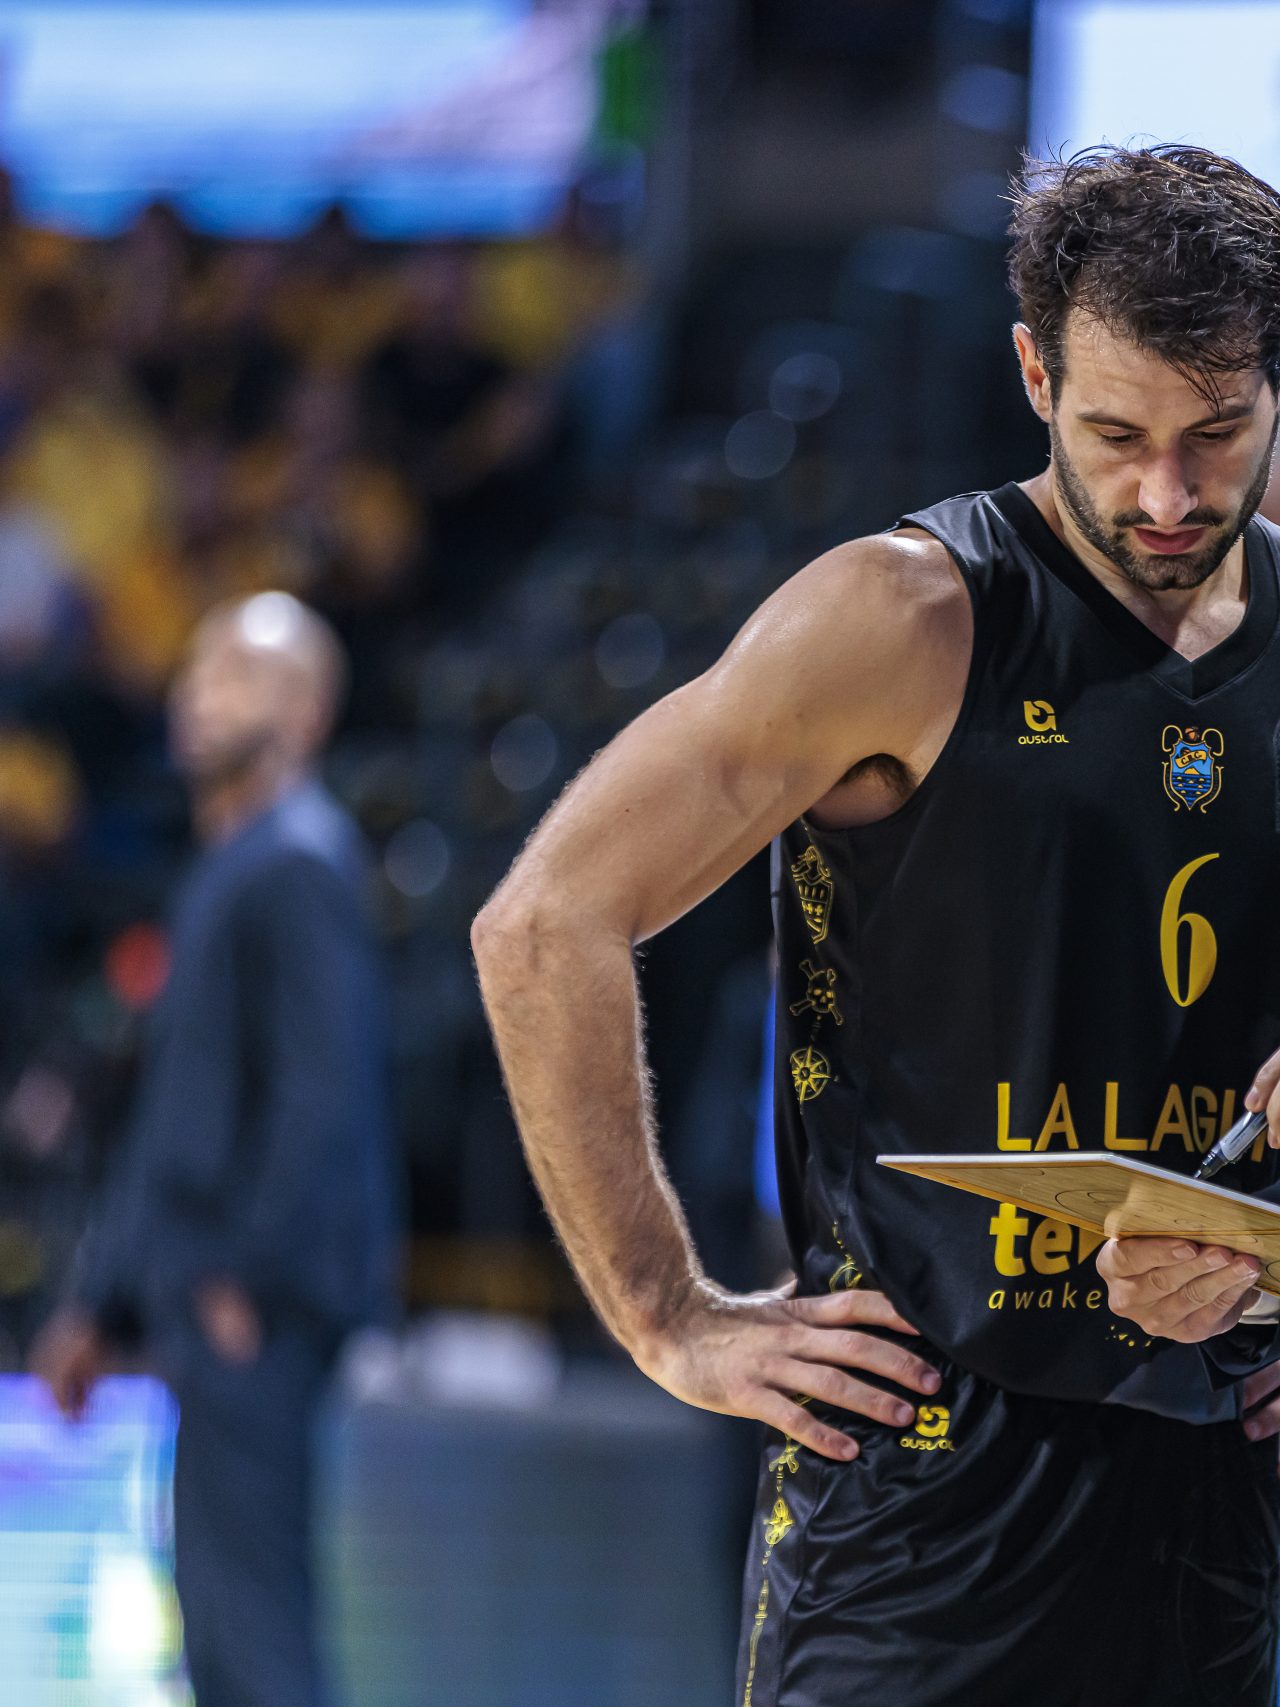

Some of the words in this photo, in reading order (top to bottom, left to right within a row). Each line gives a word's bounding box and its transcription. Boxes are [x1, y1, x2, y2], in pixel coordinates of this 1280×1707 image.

[1018, 734, 1069, 745] austral
[1160, 852, 1220, 1007] 6
[997, 1081, 1080, 1152] LA
